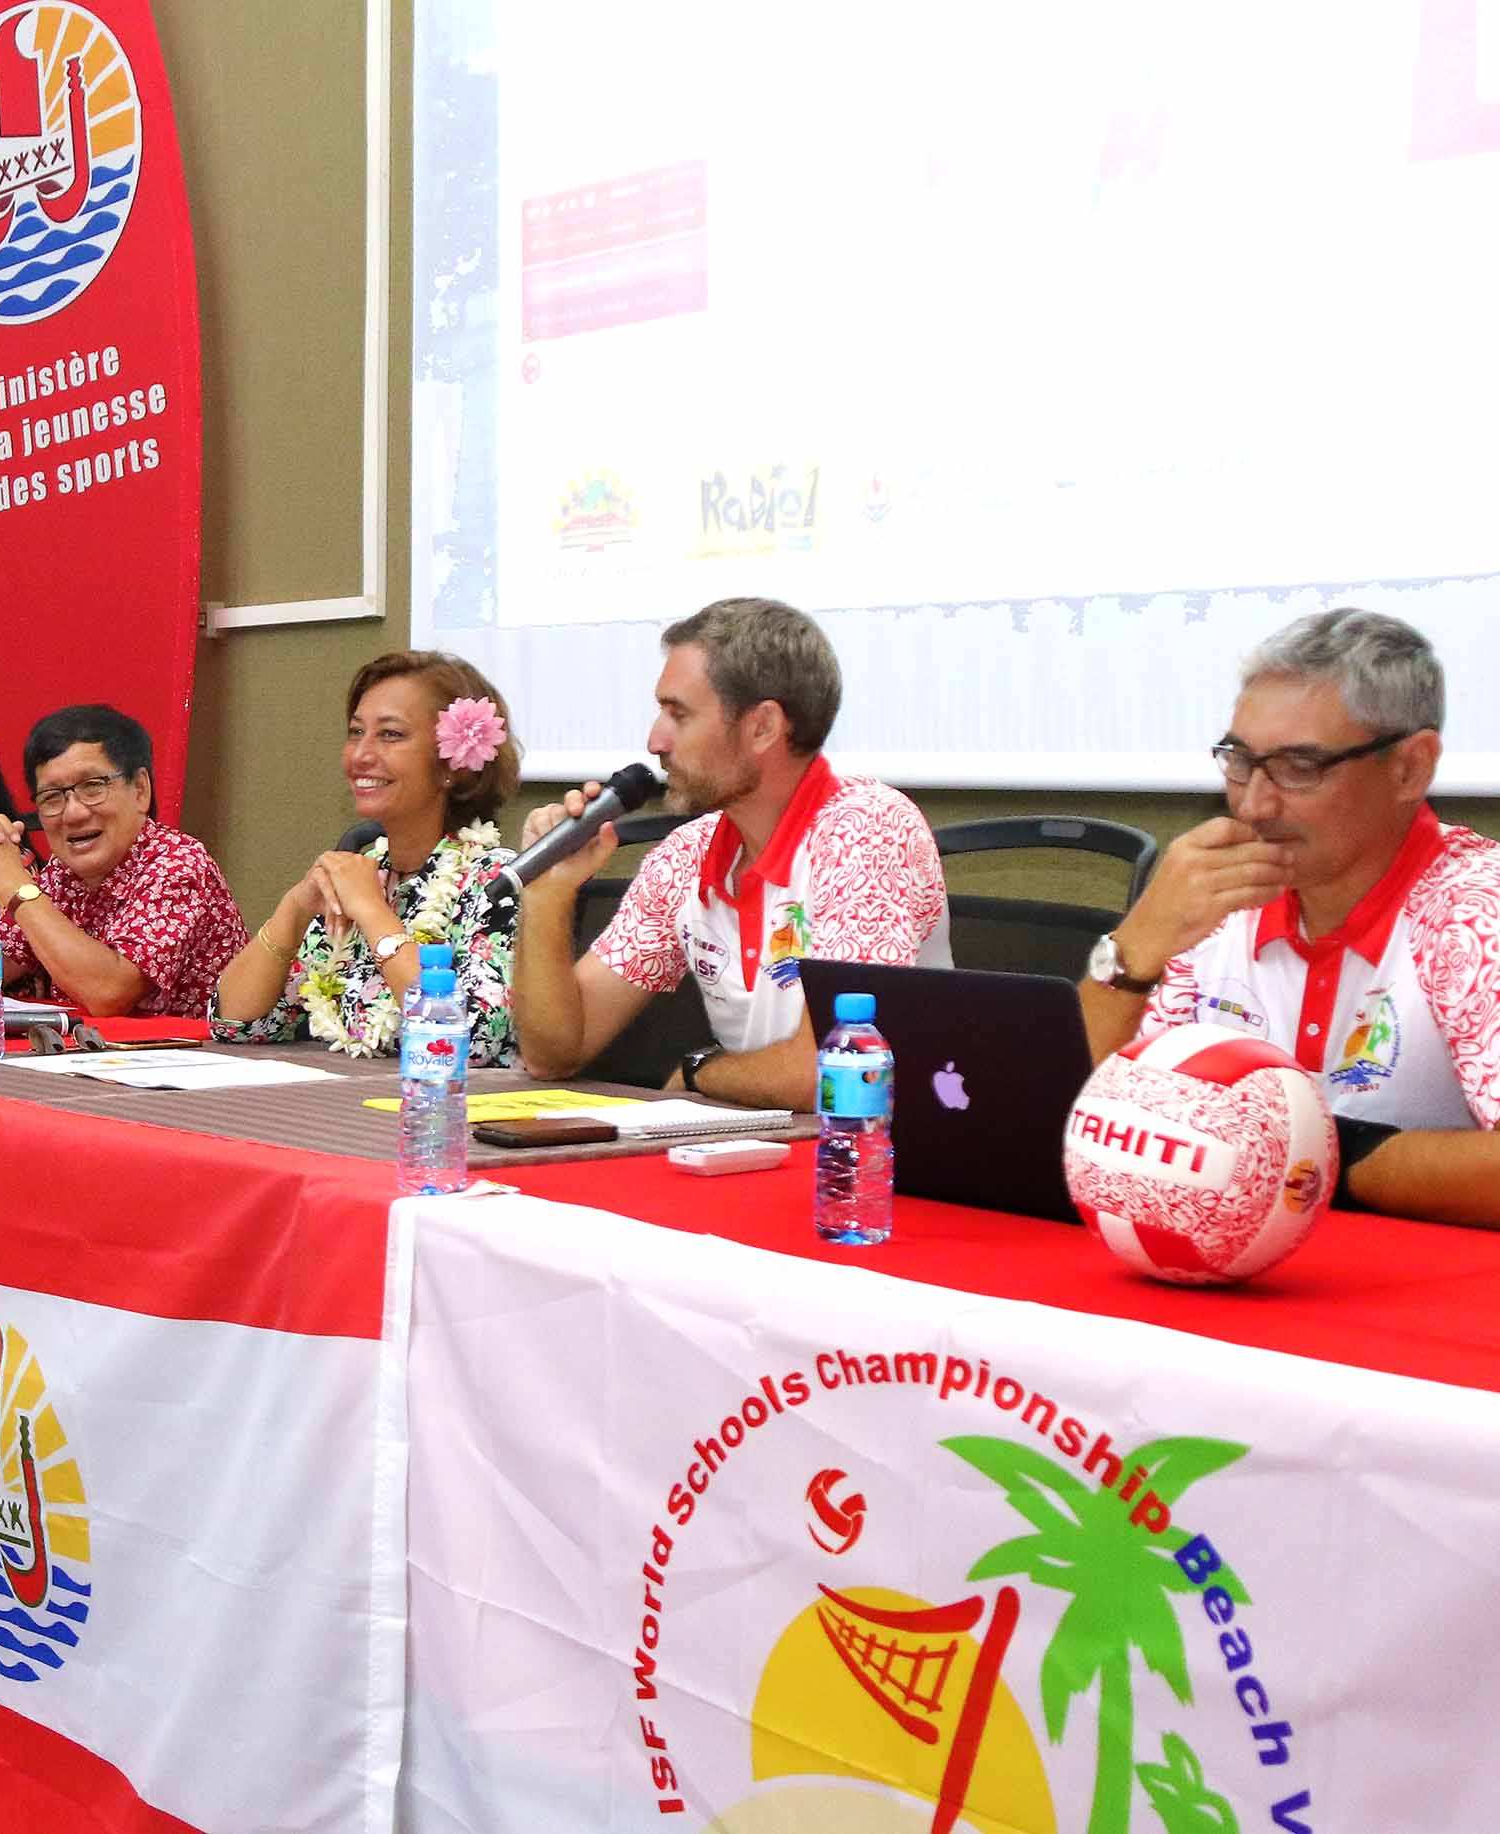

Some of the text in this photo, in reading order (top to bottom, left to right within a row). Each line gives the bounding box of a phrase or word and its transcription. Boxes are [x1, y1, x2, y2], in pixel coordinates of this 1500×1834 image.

[21, 383, 166, 457] jeunesse
[56, 438, 160, 494] sports
[694, 957, 719, 977] ISF
[407, 1050, 455, 1069] Royale
[1071, 1109, 1207, 1174] TAHITI
[667, 1372, 811, 1526] Schools
[815, 1349, 1171, 1536] Championship
[633, 1524, 674, 1700] World
[1174, 1533, 1293, 1767] Beach
[639, 1717, 685, 1814] ISF
